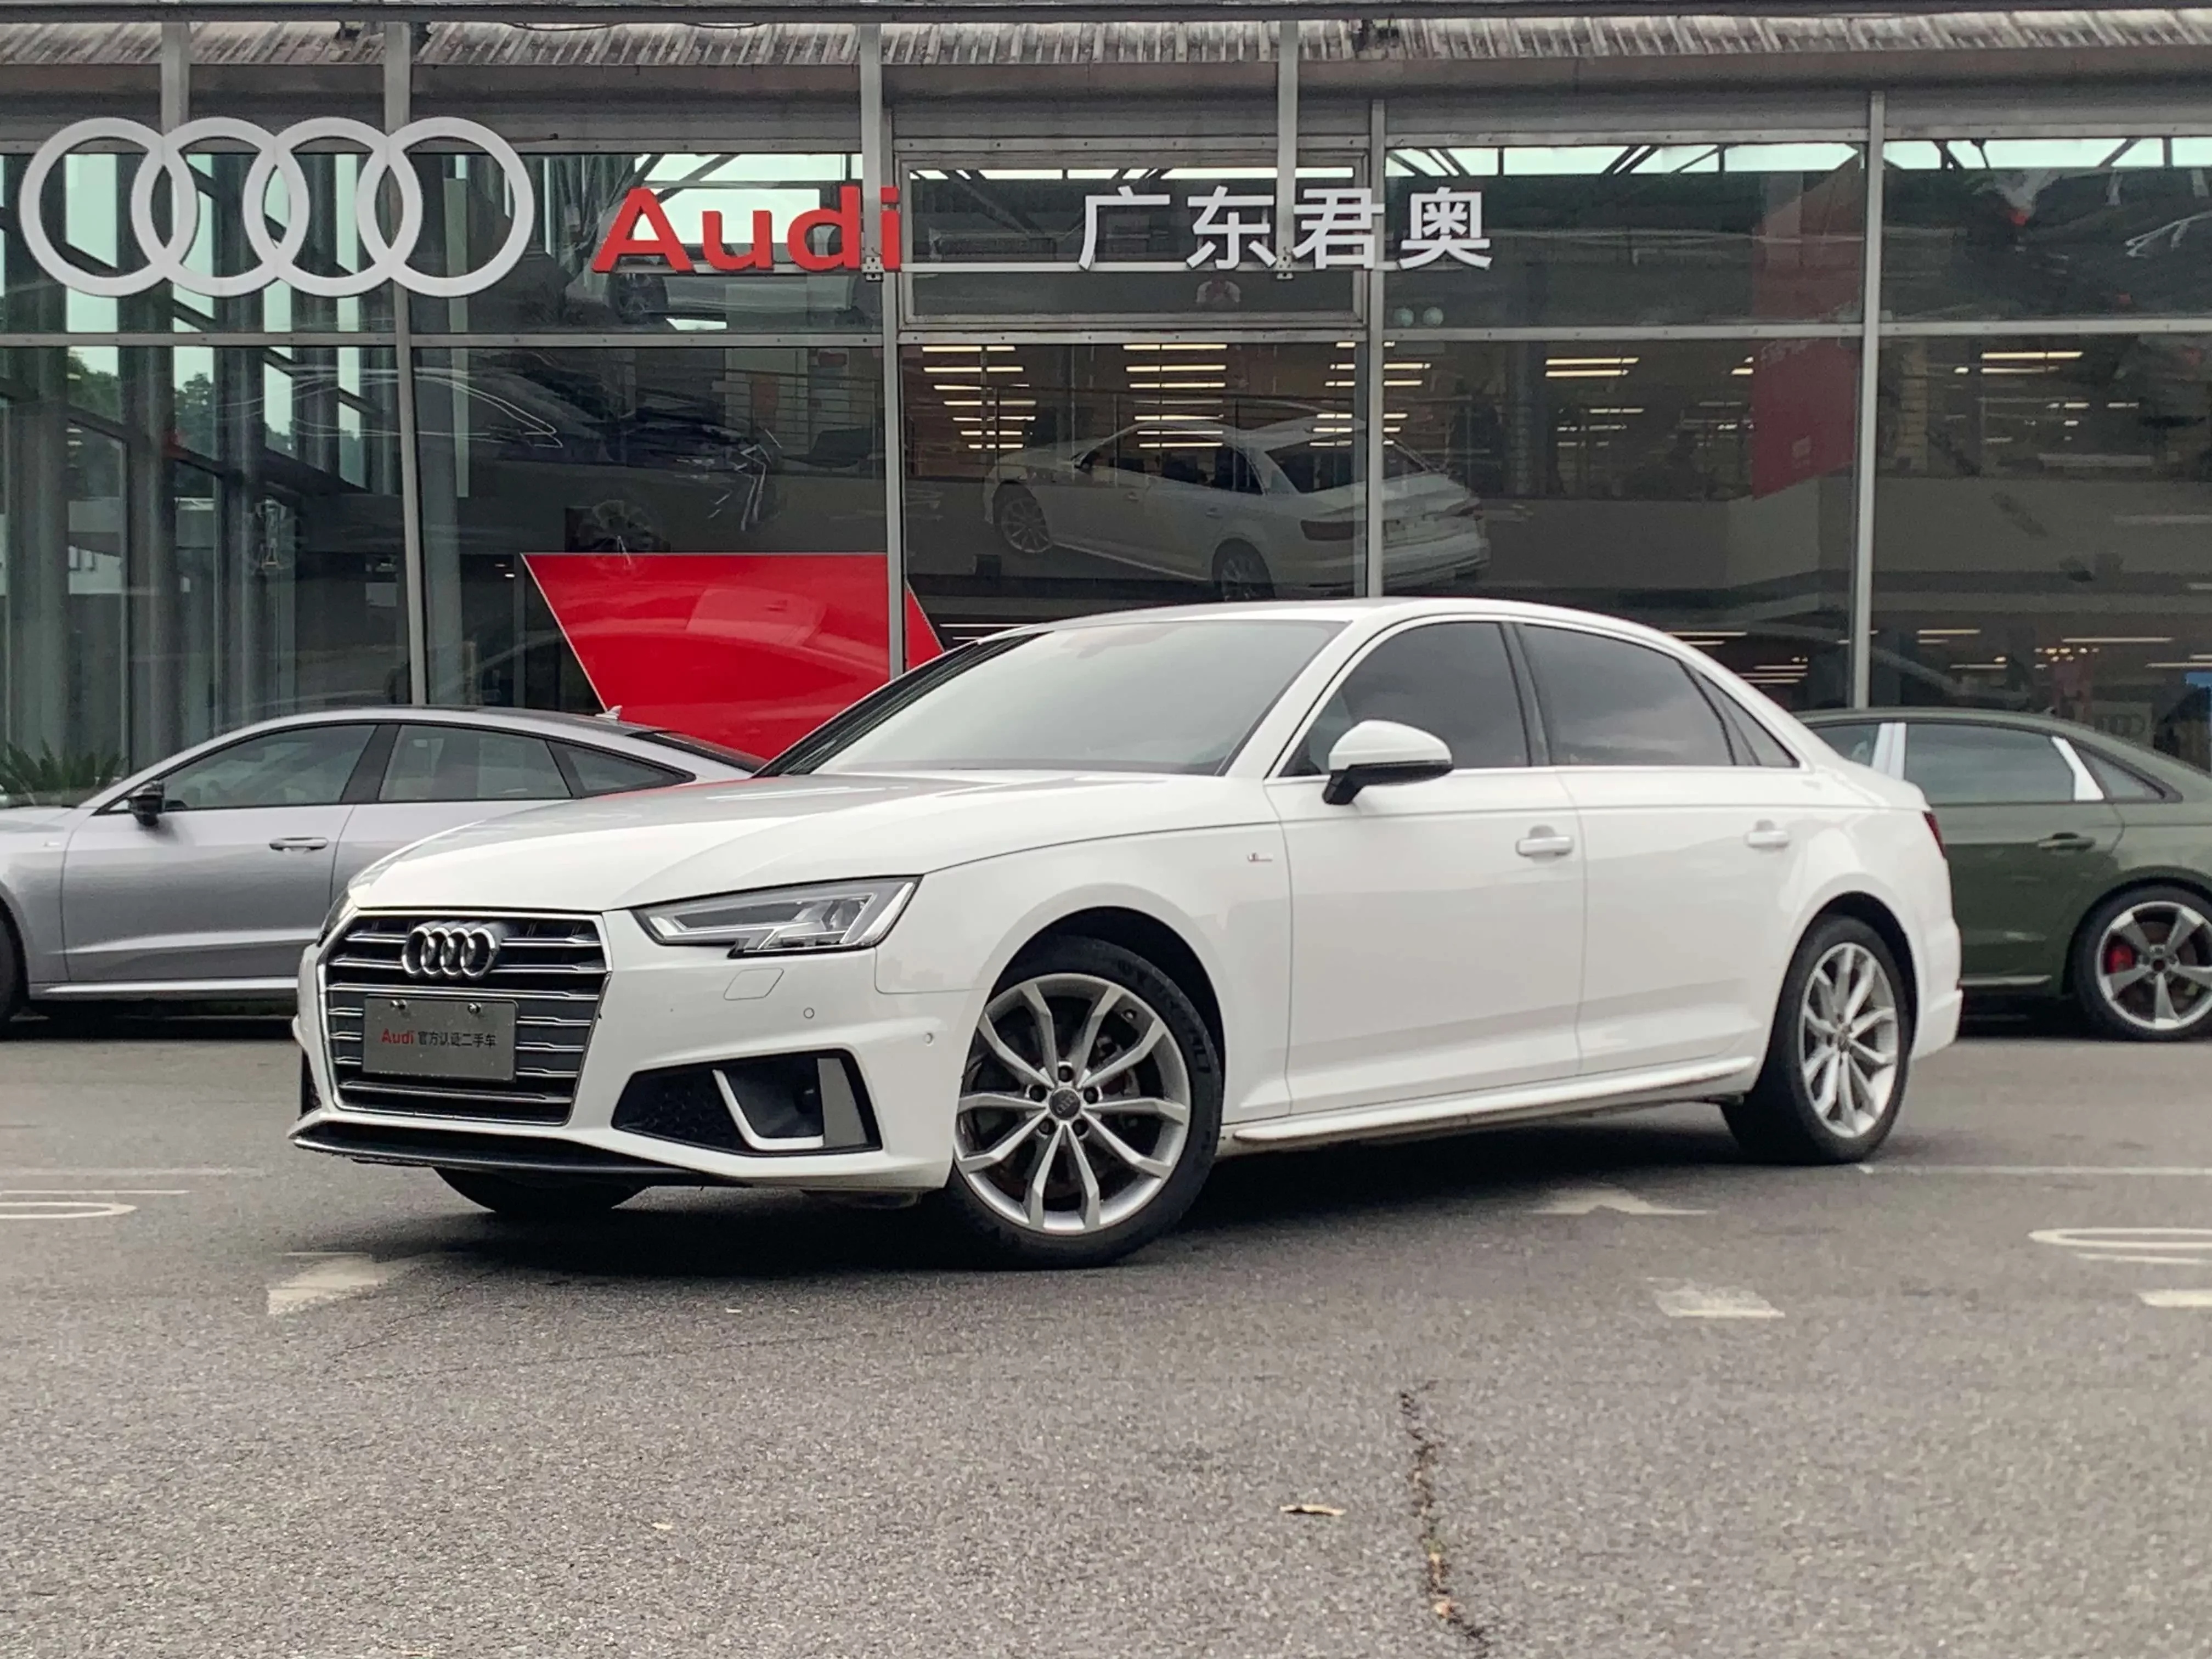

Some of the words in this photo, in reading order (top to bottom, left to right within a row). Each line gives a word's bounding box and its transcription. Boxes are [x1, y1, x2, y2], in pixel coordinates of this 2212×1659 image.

[591, 186, 902, 273] Audi
[1078, 185, 1493, 270] 广东君奥
[382, 1028, 415, 1045] Audi
